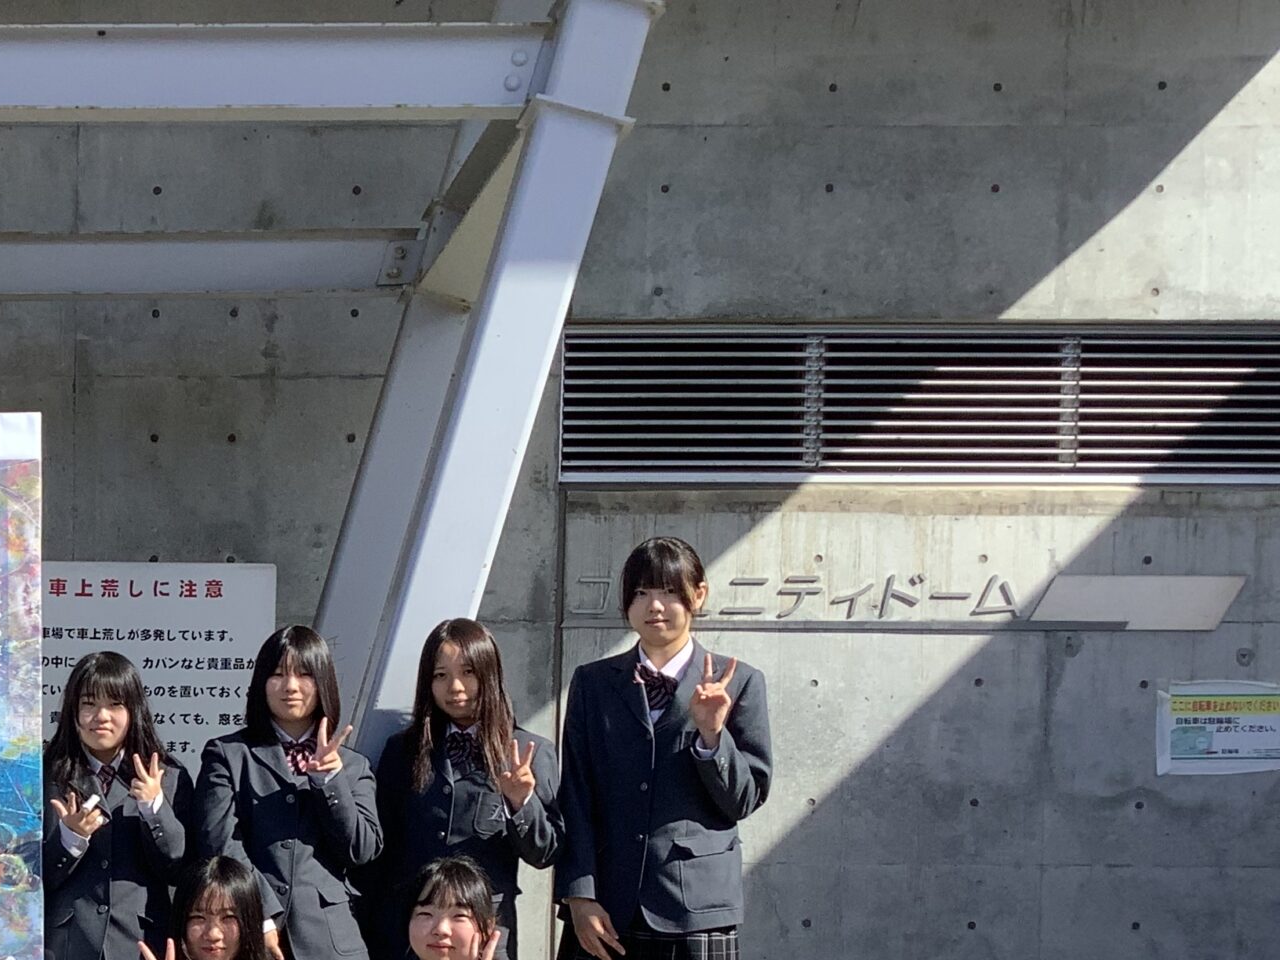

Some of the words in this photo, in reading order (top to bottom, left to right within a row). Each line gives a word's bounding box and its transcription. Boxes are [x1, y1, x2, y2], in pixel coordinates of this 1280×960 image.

[48, 578, 224, 598] 車上荒しに注意
[569, 574, 1020, 620] コニティドーム
